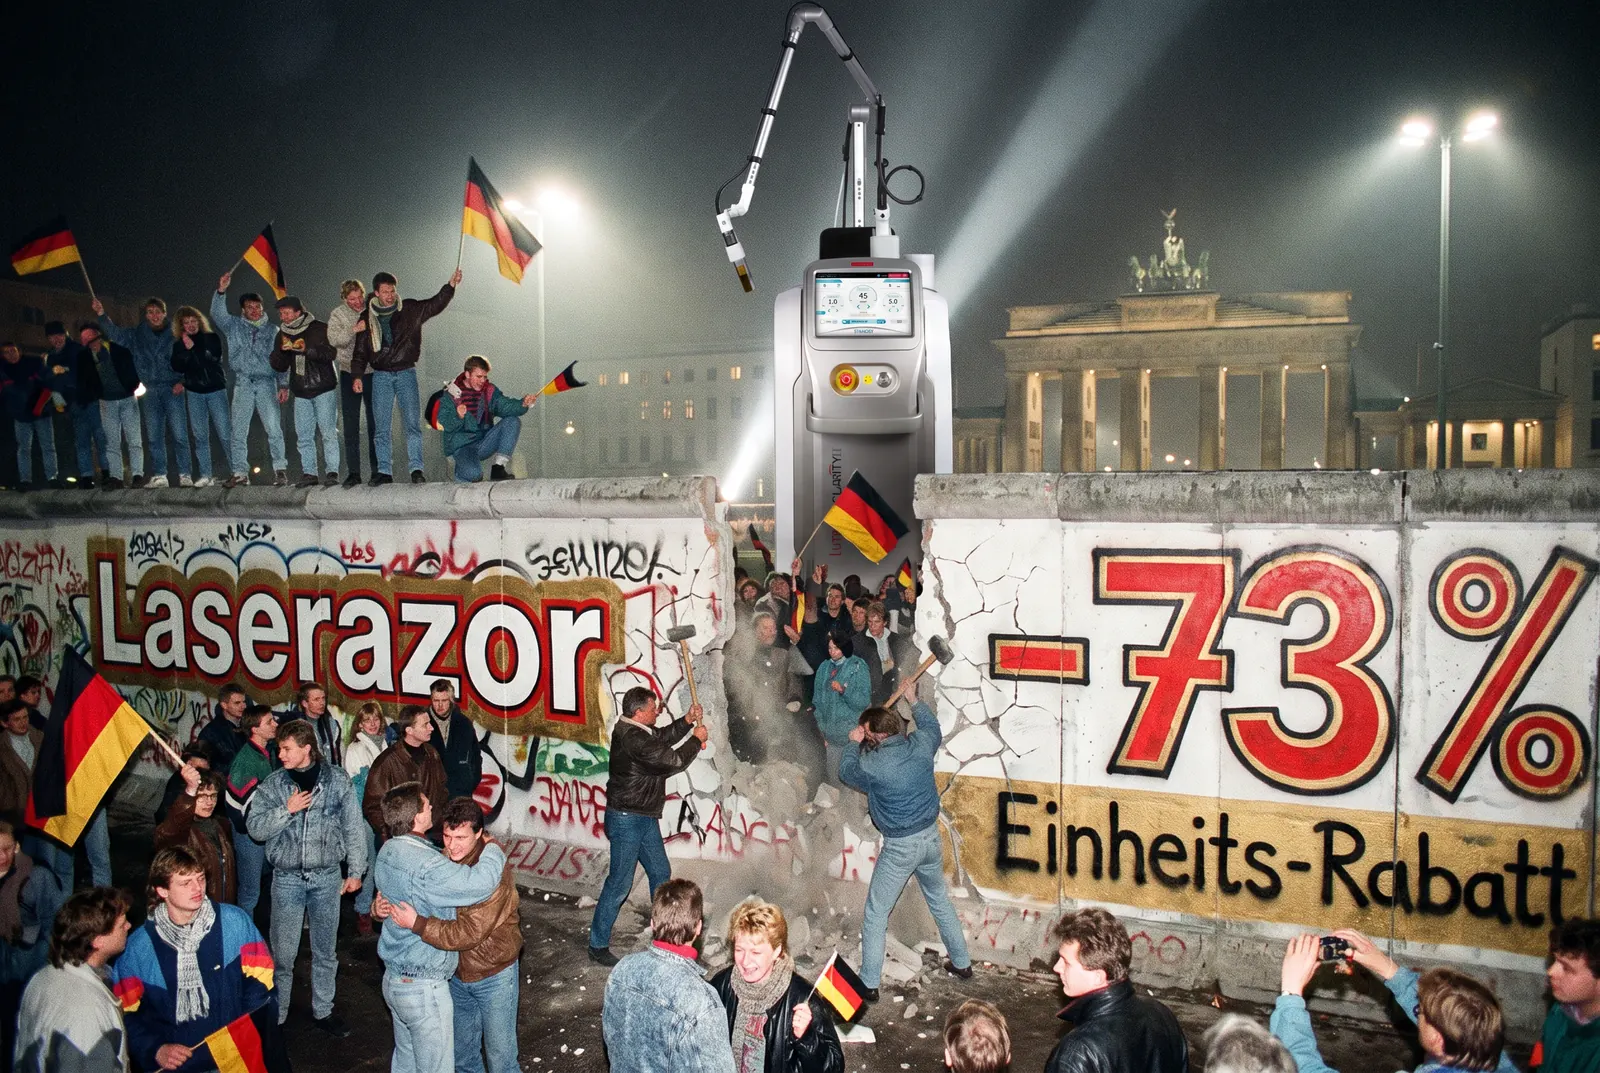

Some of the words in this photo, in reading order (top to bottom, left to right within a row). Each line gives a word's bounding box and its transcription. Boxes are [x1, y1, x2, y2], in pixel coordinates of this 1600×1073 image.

[858, 292, 869, 300] 45
[94, 552, 611, 726] Laserazor
[988, 544, 1600, 804] -73%
[995, 791, 1578, 930] Einheits-Rabatt
